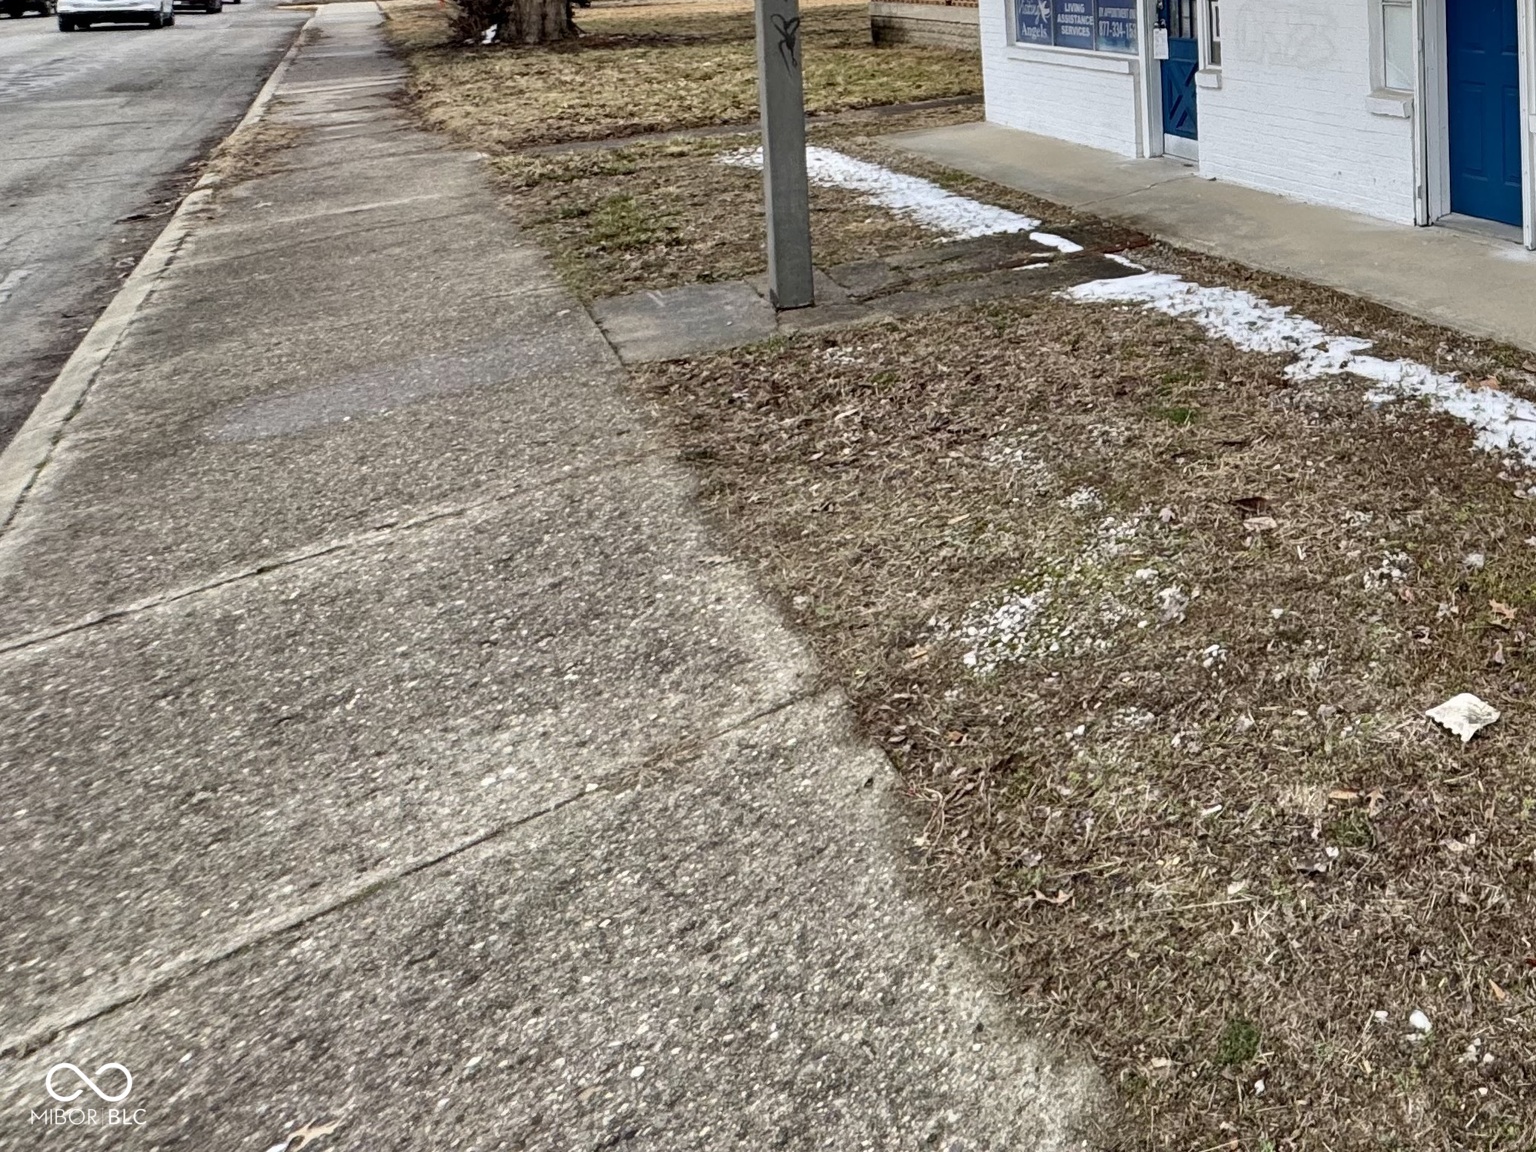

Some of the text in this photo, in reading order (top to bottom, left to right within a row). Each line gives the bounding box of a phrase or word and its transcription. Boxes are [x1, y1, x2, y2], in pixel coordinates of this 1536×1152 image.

[1064, 2, 1085, 13] LIVING
[1057, 13, 1094, 25] ASSISTANCE
[1022, 22, 1048, 40] Angels
[1061, 25, 1091, 37] SERVICES
